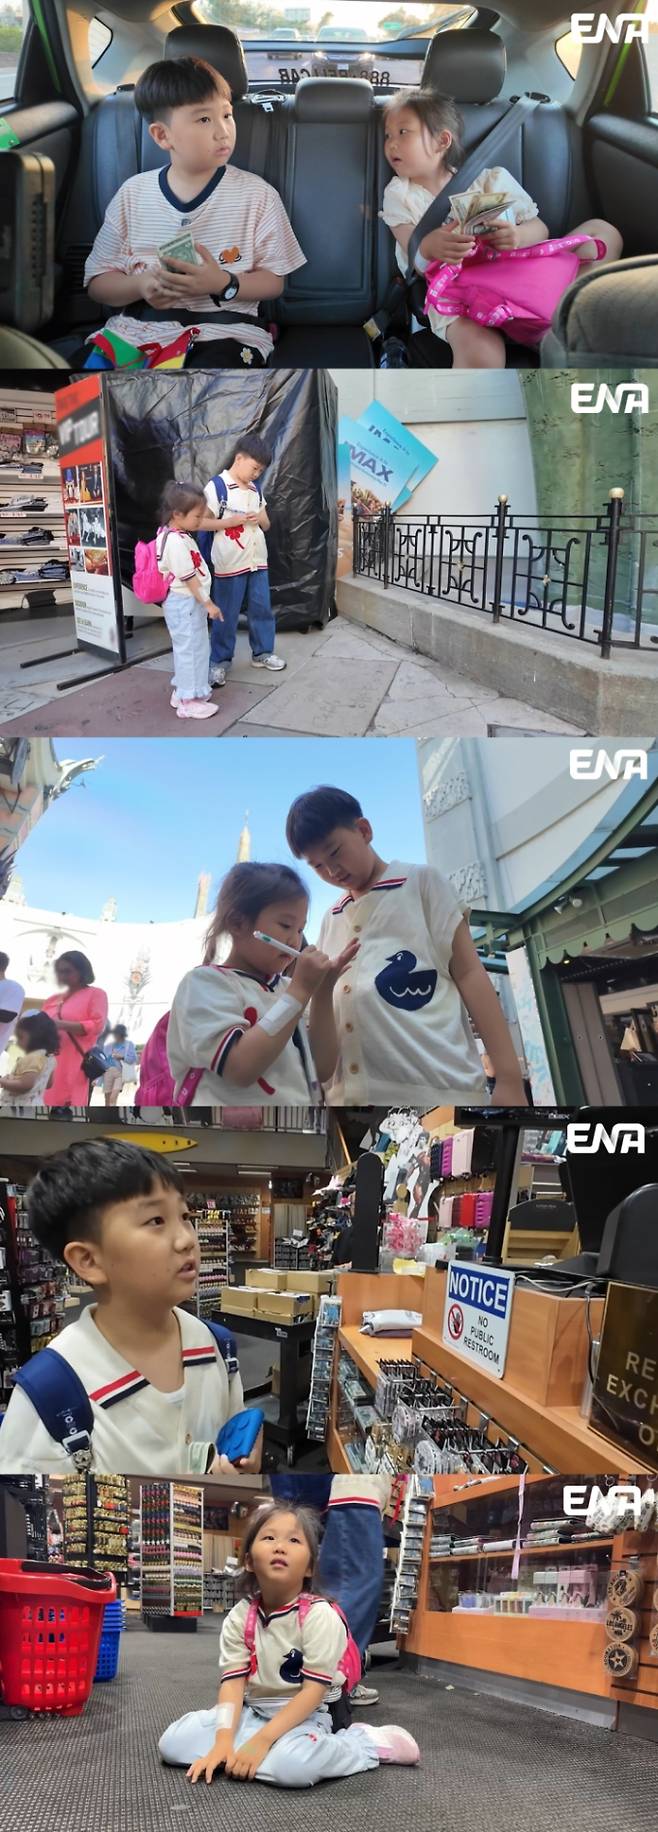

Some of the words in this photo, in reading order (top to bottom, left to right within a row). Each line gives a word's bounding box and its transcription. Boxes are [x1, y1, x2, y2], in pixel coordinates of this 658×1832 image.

[344, 441, 394, 482] MAX
[450, 1271, 508, 1312] NOTICE
[470, 1326, 494, 1346] PUBLIC
[478, 1315, 489, 1328] NO
[463, 1336, 500, 1365] RESTROOM
